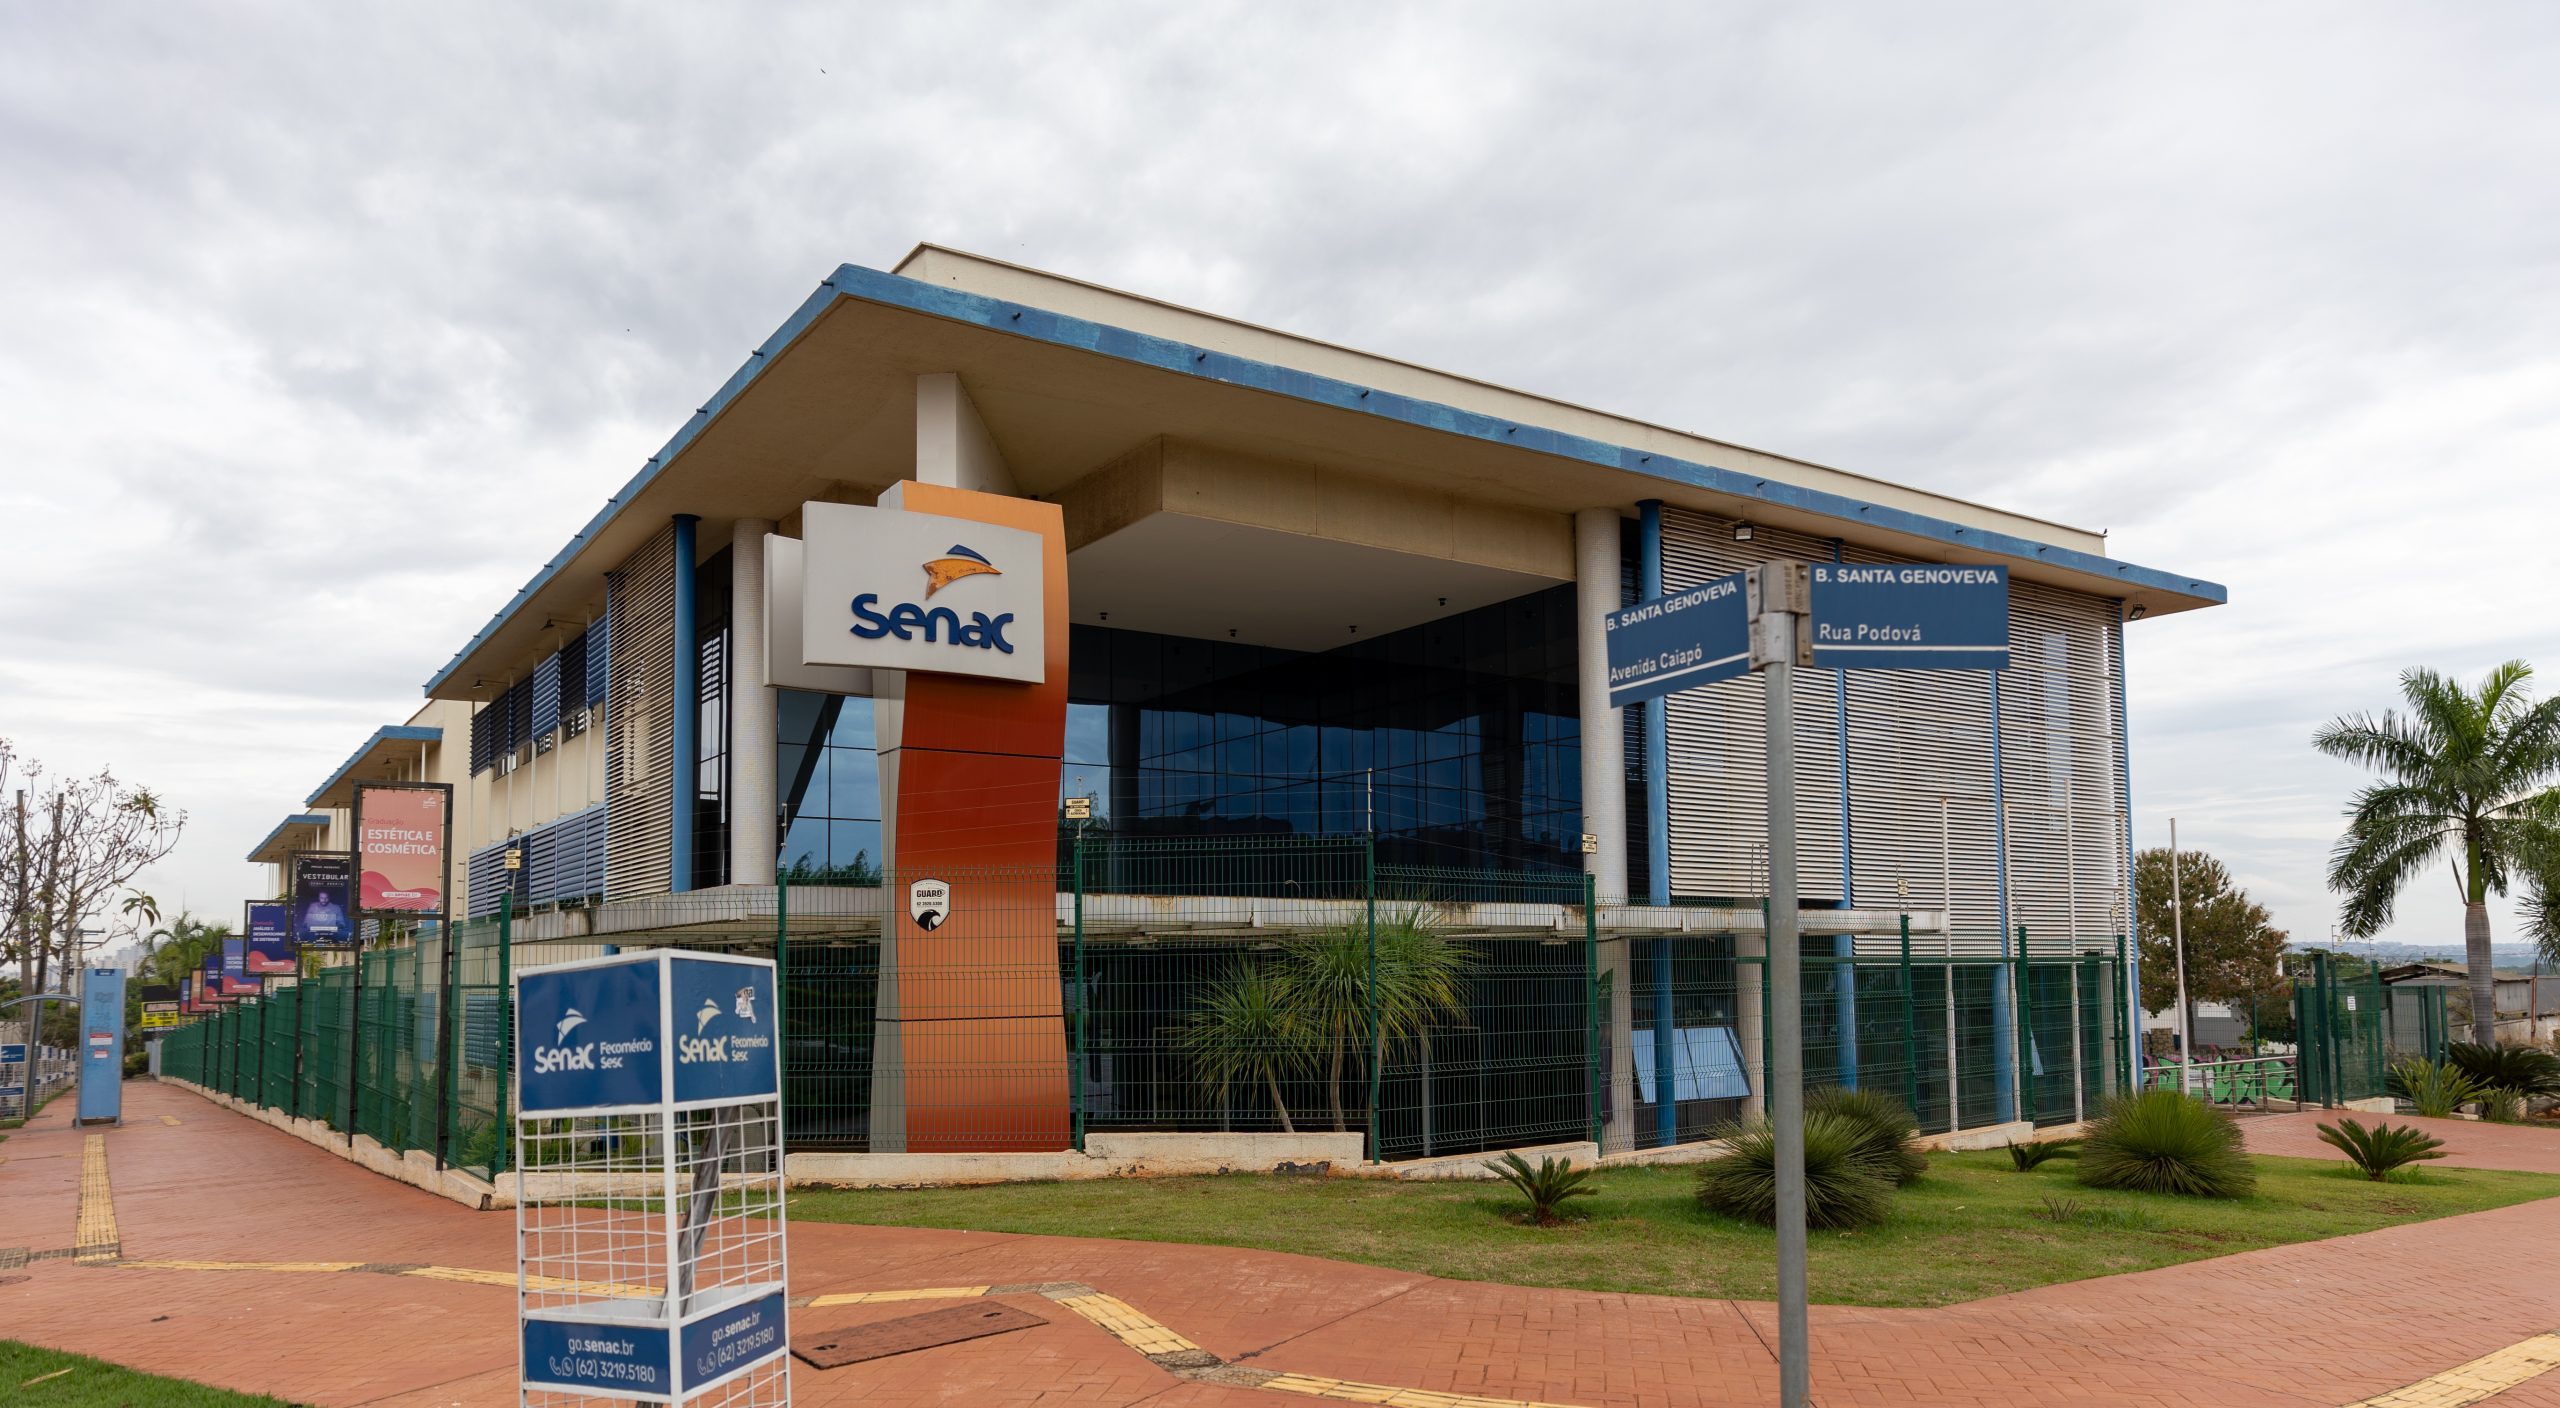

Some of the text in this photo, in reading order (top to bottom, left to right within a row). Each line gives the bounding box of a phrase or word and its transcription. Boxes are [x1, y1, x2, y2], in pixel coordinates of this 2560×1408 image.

[1815, 568, 1999, 584] B. SANTA GENOVEVA
[1607, 581, 1738, 632] B. SANTA GENOVEVA
[1819, 624, 1922, 642] Rua Podová
[1610, 644, 1703, 682] Avenida Caiapó
[368, 828, 433, 841] ESTÉTICA E
[367, 842, 437, 855] COSMÉTICA
[916, 889, 942, 898] GUARD
[600, 1037, 653, 1056] Fecomércio
[731, 1035, 769, 1049] Fecomércio
[600, 1056, 623, 1070] Sesc
[731, 1050, 749, 1063] Sesc
[711, 1310, 761, 1347] go.senac.br
[568, 1337, 635, 1356] go.senac.br
[717, 1326, 774, 1368] (62) 3219.5180
[576, 1359, 656, 1383] (62) 3219.5180
